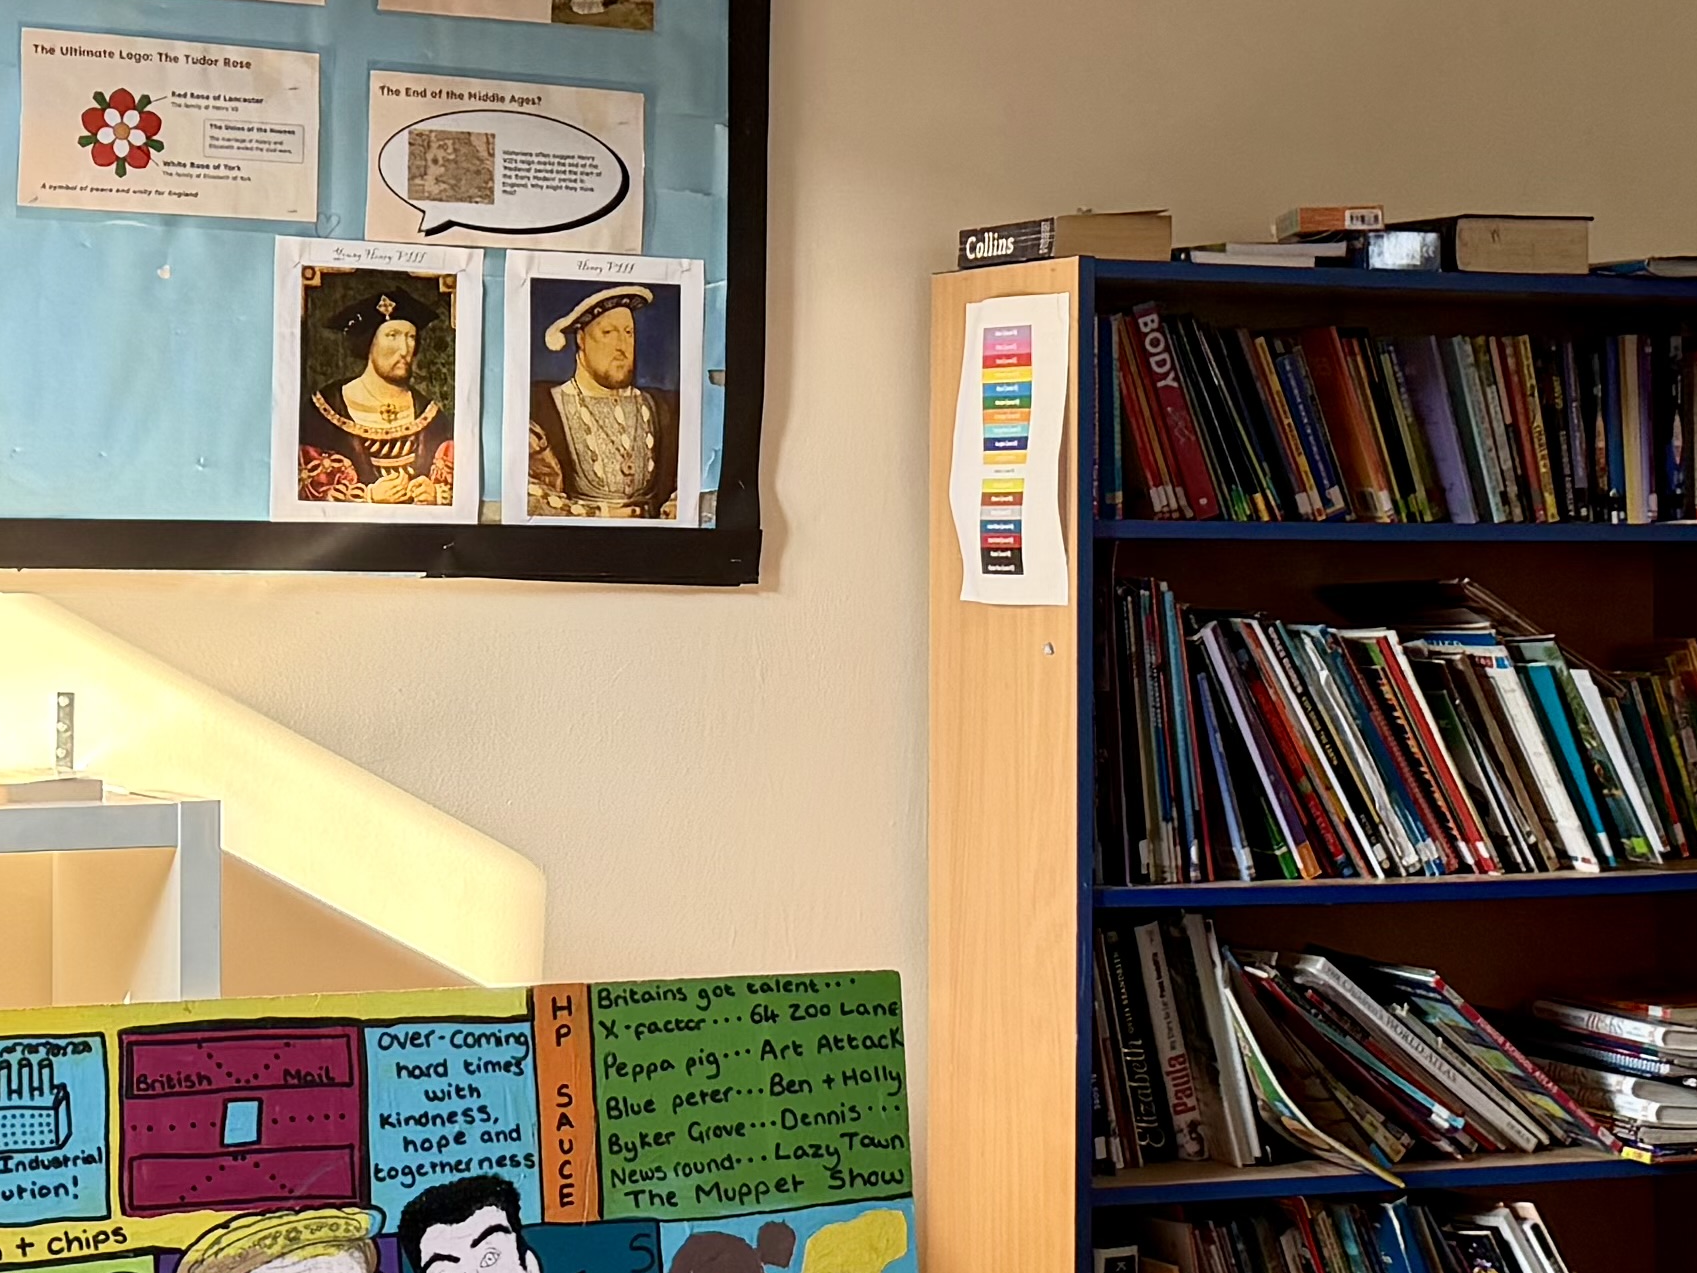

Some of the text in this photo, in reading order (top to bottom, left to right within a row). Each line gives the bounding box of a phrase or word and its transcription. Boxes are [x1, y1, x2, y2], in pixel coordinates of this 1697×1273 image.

[33, 44, 55, 55] The
[60, 46, 115, 59] Ultimate
[157, 52, 180, 64] The
[184, 54, 219, 67] Tudor
[223, 57, 252, 69] Rose
[379, 85, 542, 106] The End of the Middle Ages?
[965, 232, 1014, 260] Collins
[1138, 314, 1179, 389] BODY
[597, 983, 737, 1015] Britains got
[1380, 1014, 1427, 1055] WORLD
[396, 1059, 448, 1079] hard
[603, 1027, 904, 1083] Peppa Art Attack
[283, 1066, 336, 1085] Mail
[1167, 1052, 1196, 1117] Paula
[424, 1082, 481, 1102] with
[606, 1066, 903, 1119] Blue Ben Holly
[1124, 1039, 1165, 1148] Elizabeth
[403, 1123, 521, 1154] hope and
[774, 1131, 904, 1171] Lazy Town
[624, 1186, 678, 1211] The
